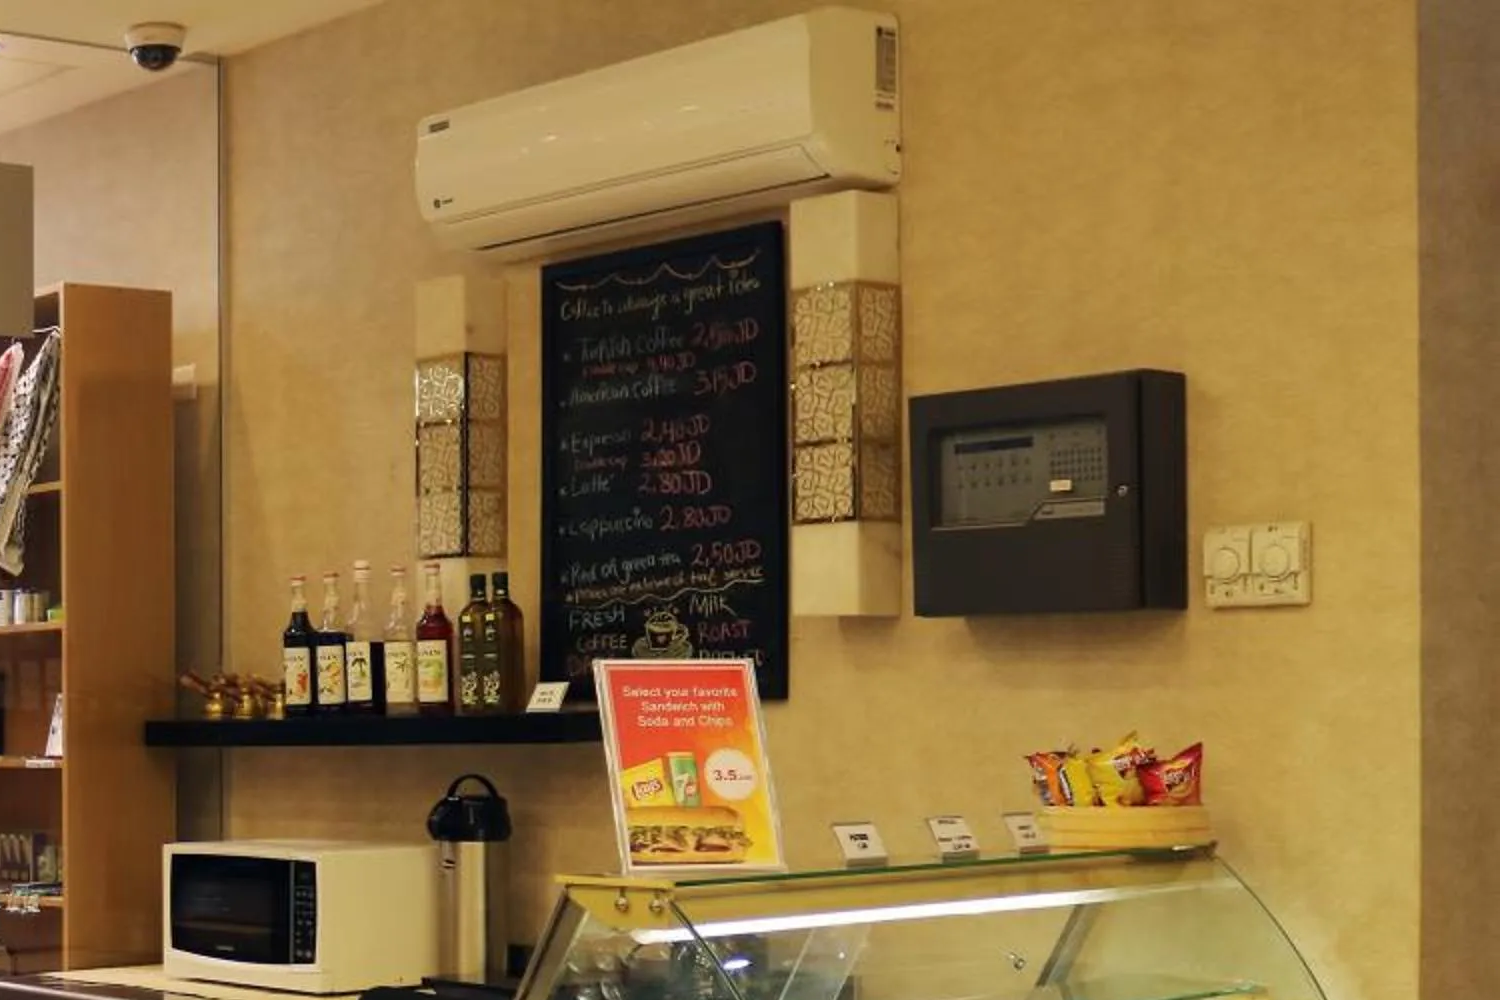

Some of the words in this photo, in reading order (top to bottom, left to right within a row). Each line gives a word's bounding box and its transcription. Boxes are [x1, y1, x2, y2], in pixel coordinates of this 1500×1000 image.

[622, 687, 661, 698] Select
[663, 687, 689, 699] your
[641, 701, 698, 713] Sandwich
[701, 701, 725, 712] with
[638, 715, 669, 728] Soda
[673, 715, 695, 728] and
[698, 715, 734, 730] Chips
